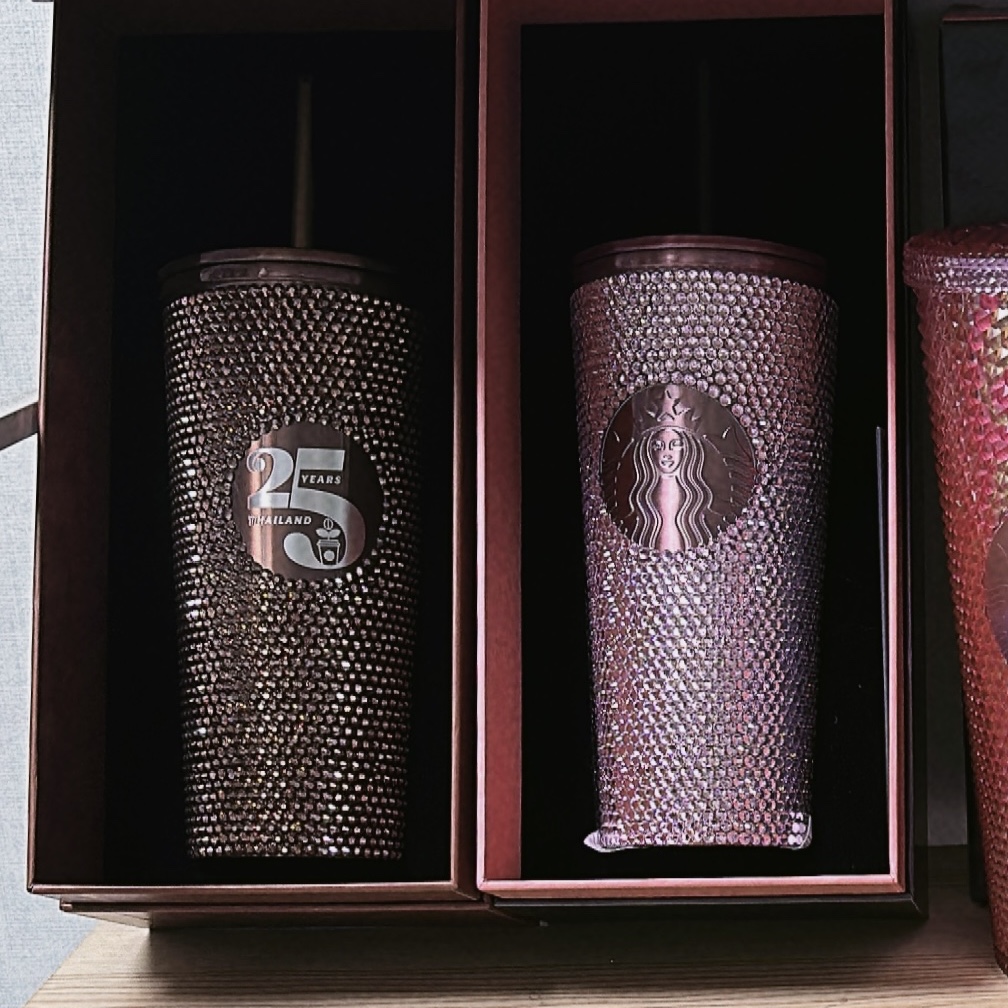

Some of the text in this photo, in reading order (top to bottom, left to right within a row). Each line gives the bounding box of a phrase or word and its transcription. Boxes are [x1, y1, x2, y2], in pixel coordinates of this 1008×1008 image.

[301, 474, 342, 485] YEARS
[246, 447, 366, 570] 25
[248, 514, 312, 527] THAILAND
